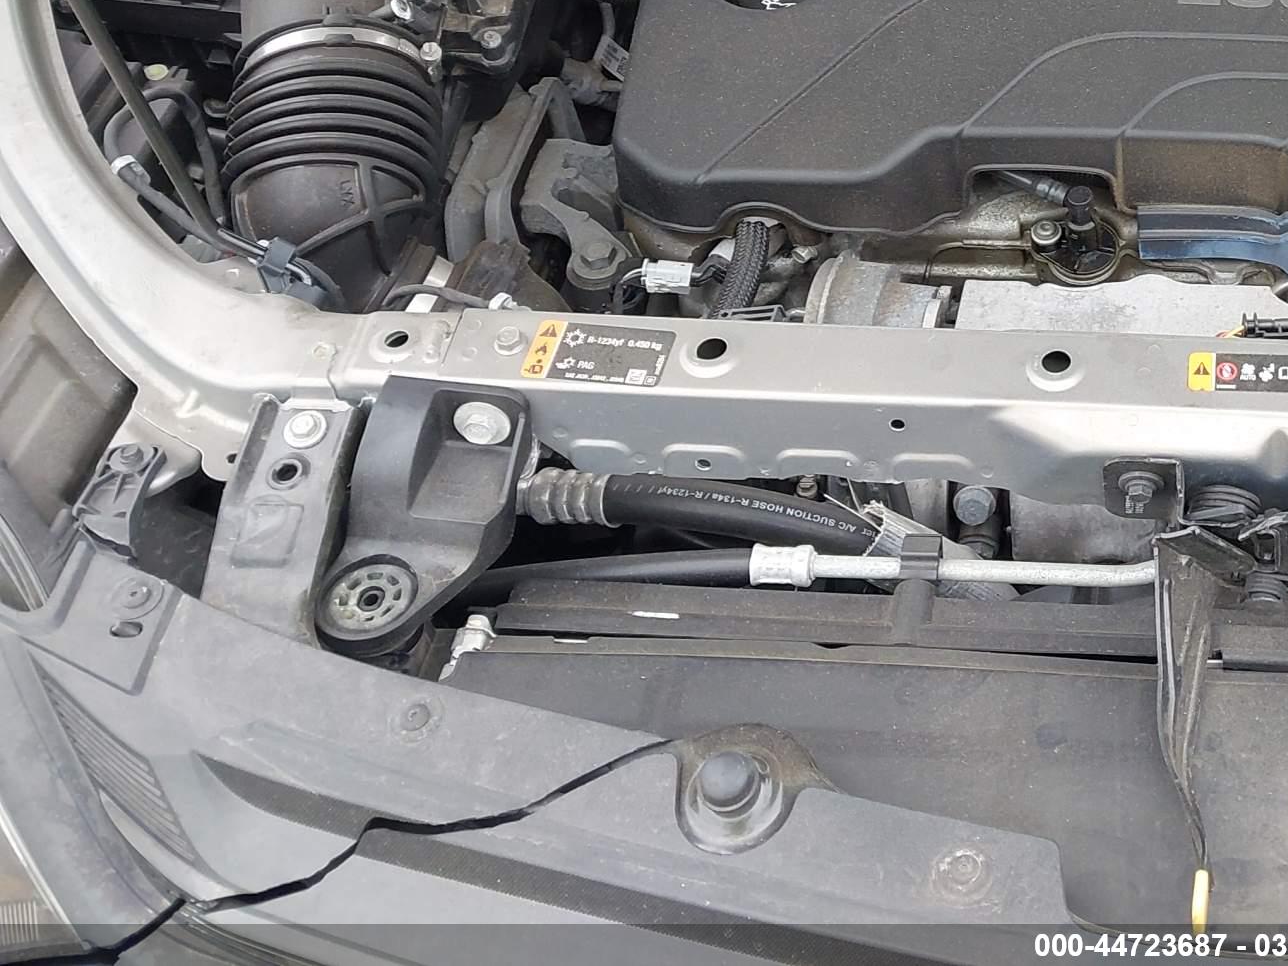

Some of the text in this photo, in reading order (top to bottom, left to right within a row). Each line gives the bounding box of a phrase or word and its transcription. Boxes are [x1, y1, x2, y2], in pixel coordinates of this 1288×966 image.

[577, 359, 595, 371] PAG
[711, 492, 749, 507] R-134a
[751, 499, 784, 514] HOSE
[785, 507, 836, 527] SUCTION
